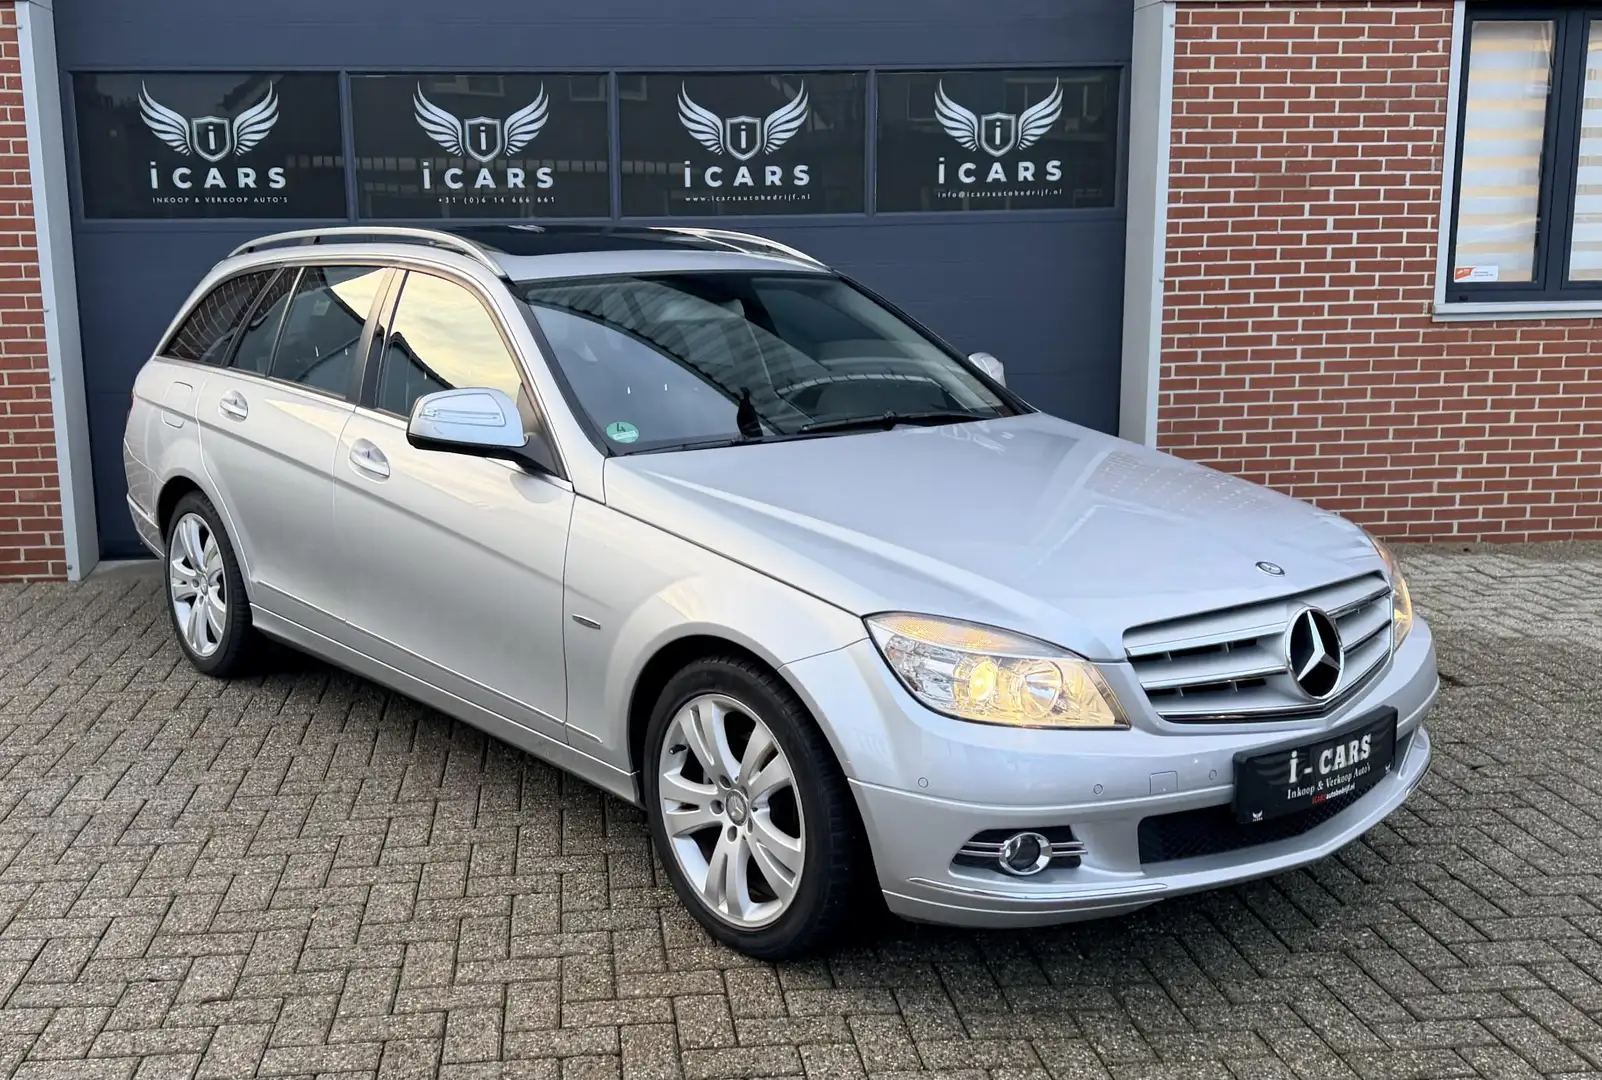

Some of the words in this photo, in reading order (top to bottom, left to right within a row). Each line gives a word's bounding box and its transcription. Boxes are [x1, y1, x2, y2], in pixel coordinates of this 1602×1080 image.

[208, 125, 216, 150] i
[480, 126, 487, 150] i
[740, 125, 747, 149] i
[995, 121, 1001, 145] i
[152, 196, 190, 204] INKOOP
[194, 196, 201, 204] &
[205, 196, 249, 204] VERKOOP
[253, 196, 288, 204] AUTO'S
[438, 196, 456, 204] +31
[494, 196, 505, 204] 14
[512, 196, 530, 204] 666
[537, 196, 555, 204] 661
[685, 193, 811, 202] www.icarsautobedrijf.nl
[937, 188, 1062, 199] info@icarsautobedrijf.nl
[616, 422, 626, 432] 4
[1287, 785, 1315, 800] Inkoop
[1316, 780, 1324, 791] &
[1325, 773, 1352, 788] Verkoop
[1352, 762, 1371, 779] Auto's
